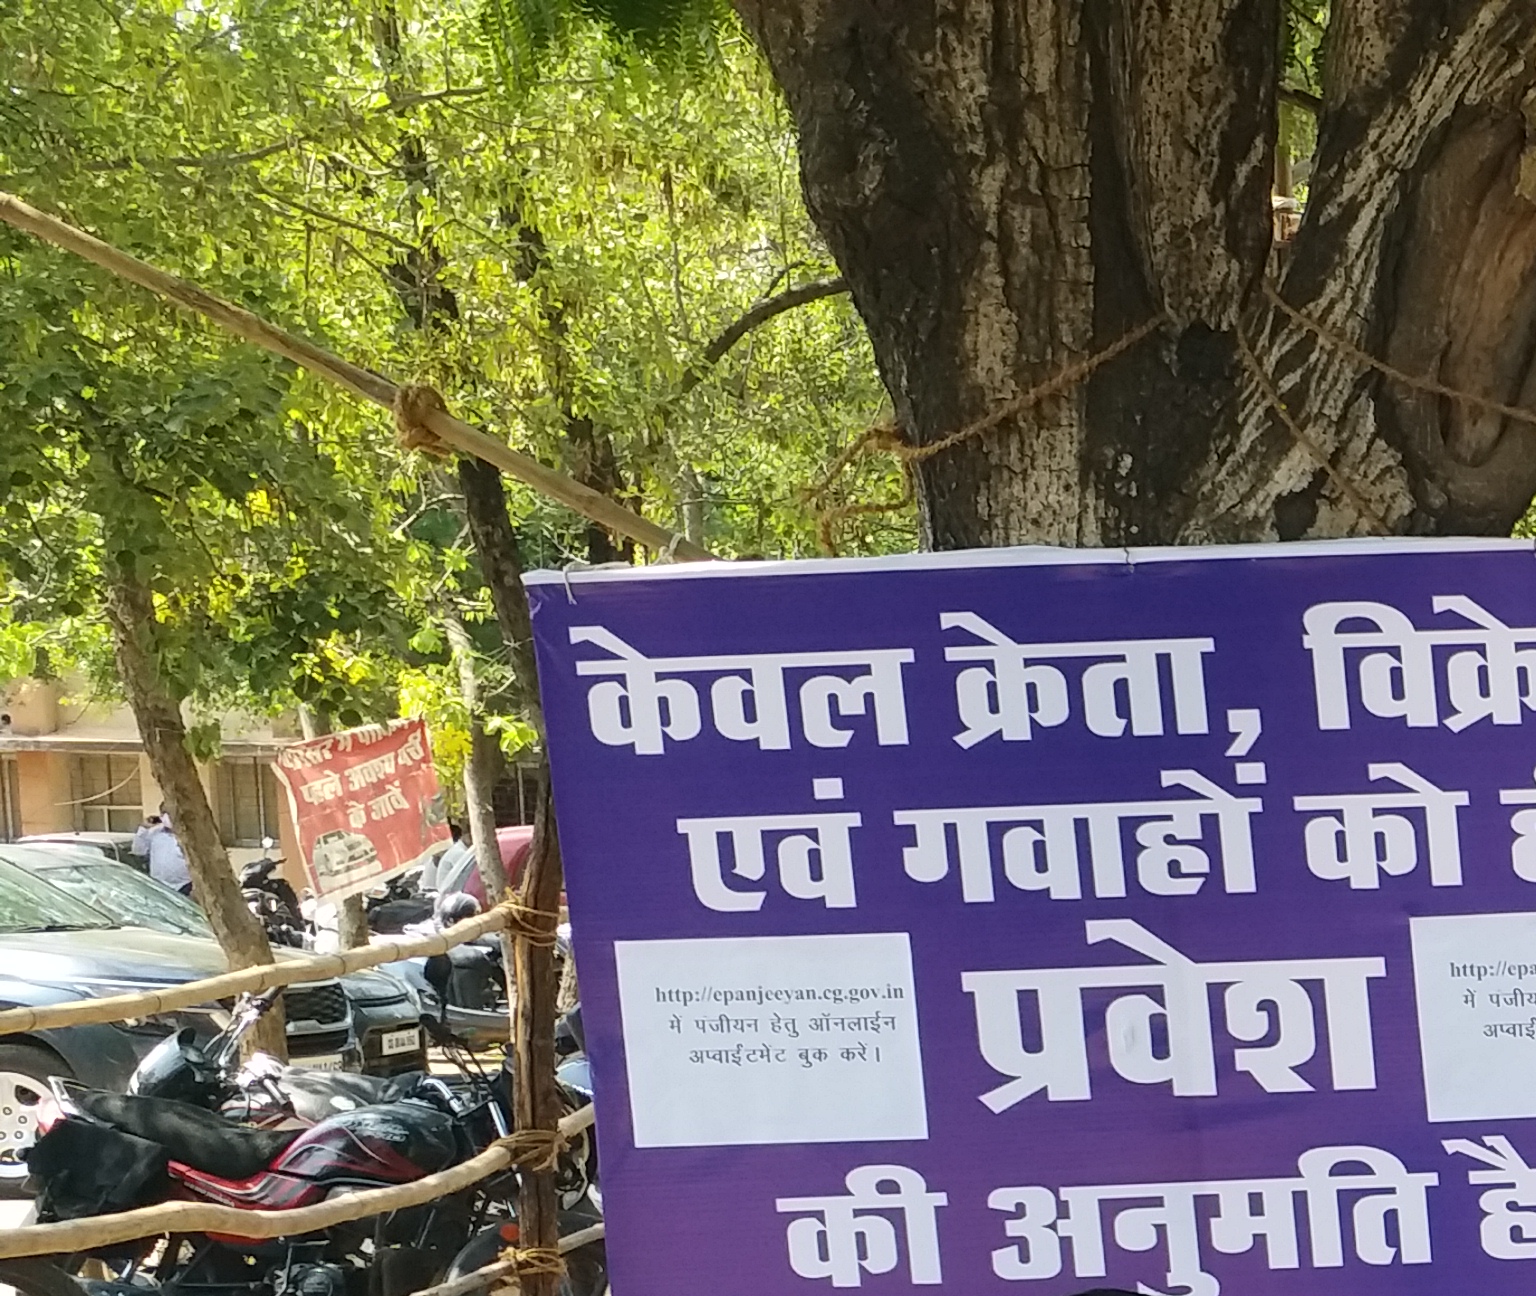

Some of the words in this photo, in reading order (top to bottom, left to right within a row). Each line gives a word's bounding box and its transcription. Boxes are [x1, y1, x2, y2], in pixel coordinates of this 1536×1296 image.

[569, 626, 914, 754] केवल
[940, 612, 1261, 758] क्रेता,
[677, 778, 861, 911] एवं
[894, 762, 1266, 902] गवाहों
[1294, 763, 1469, 889] को
[655, 983, 904, 1006] http://epanjeeyan.cg.gov.in
[669, 1014, 682, 1034] में
[769, 1012, 799, 1038] हेतु
[808, 1010, 896, 1034] ऑनलाईन
[961, 919, 1386, 1113] प्रवेश
[1463, 988, 1476, 1008] में
[798, 1048, 828, 1068] बुक
[776, 1165, 947, 1287] की
